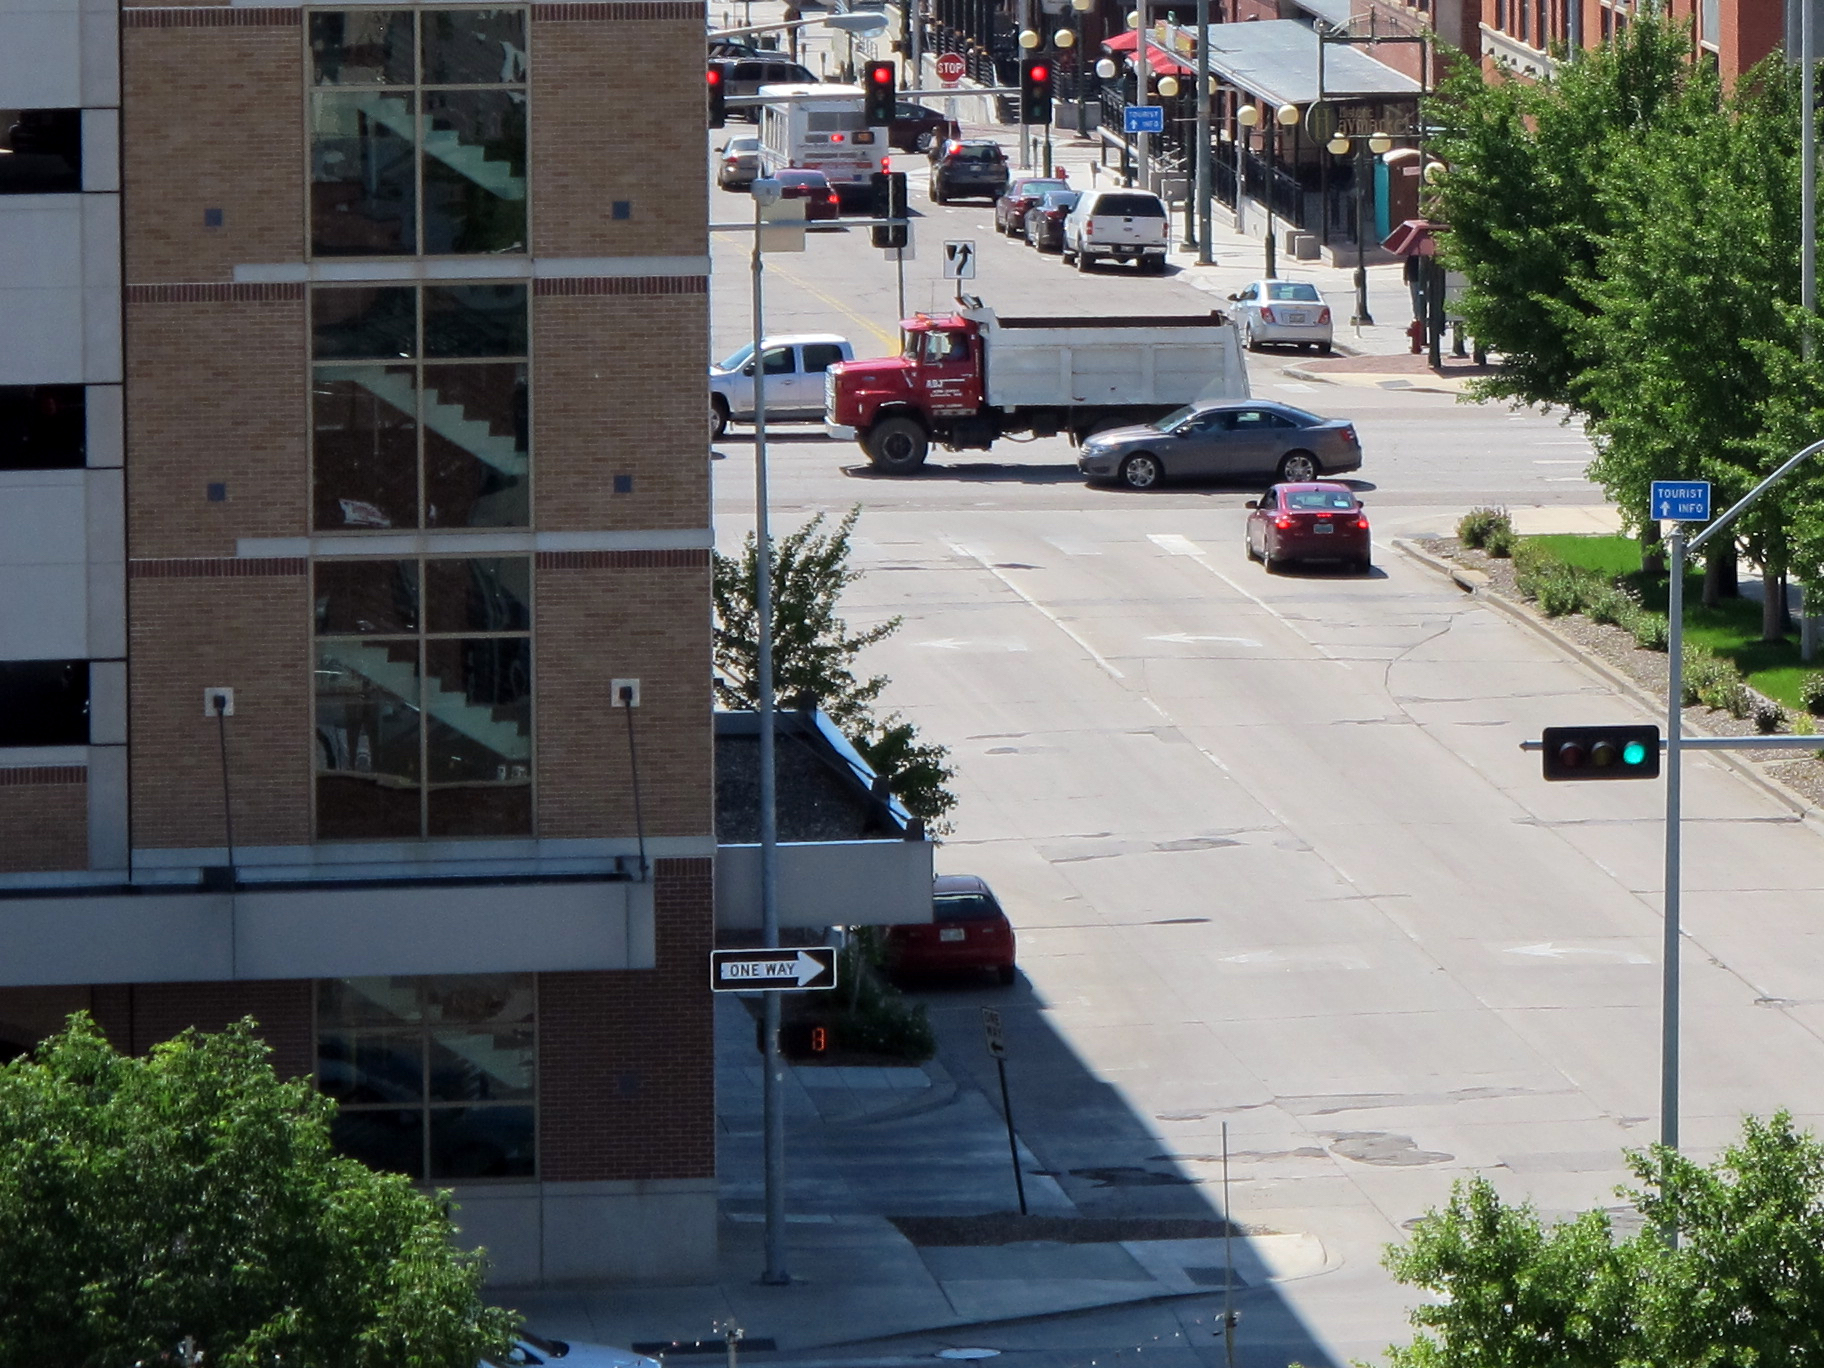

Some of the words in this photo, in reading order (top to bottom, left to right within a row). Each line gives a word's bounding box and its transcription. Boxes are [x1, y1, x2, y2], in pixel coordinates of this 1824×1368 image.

[938, 62, 964, 74] STOP
[1658, 488, 1703, 499] TOURIST
[1678, 503, 1703, 513] INFO
[730, 964, 759, 977] ONE
[765, 962, 795, 976] WAY
